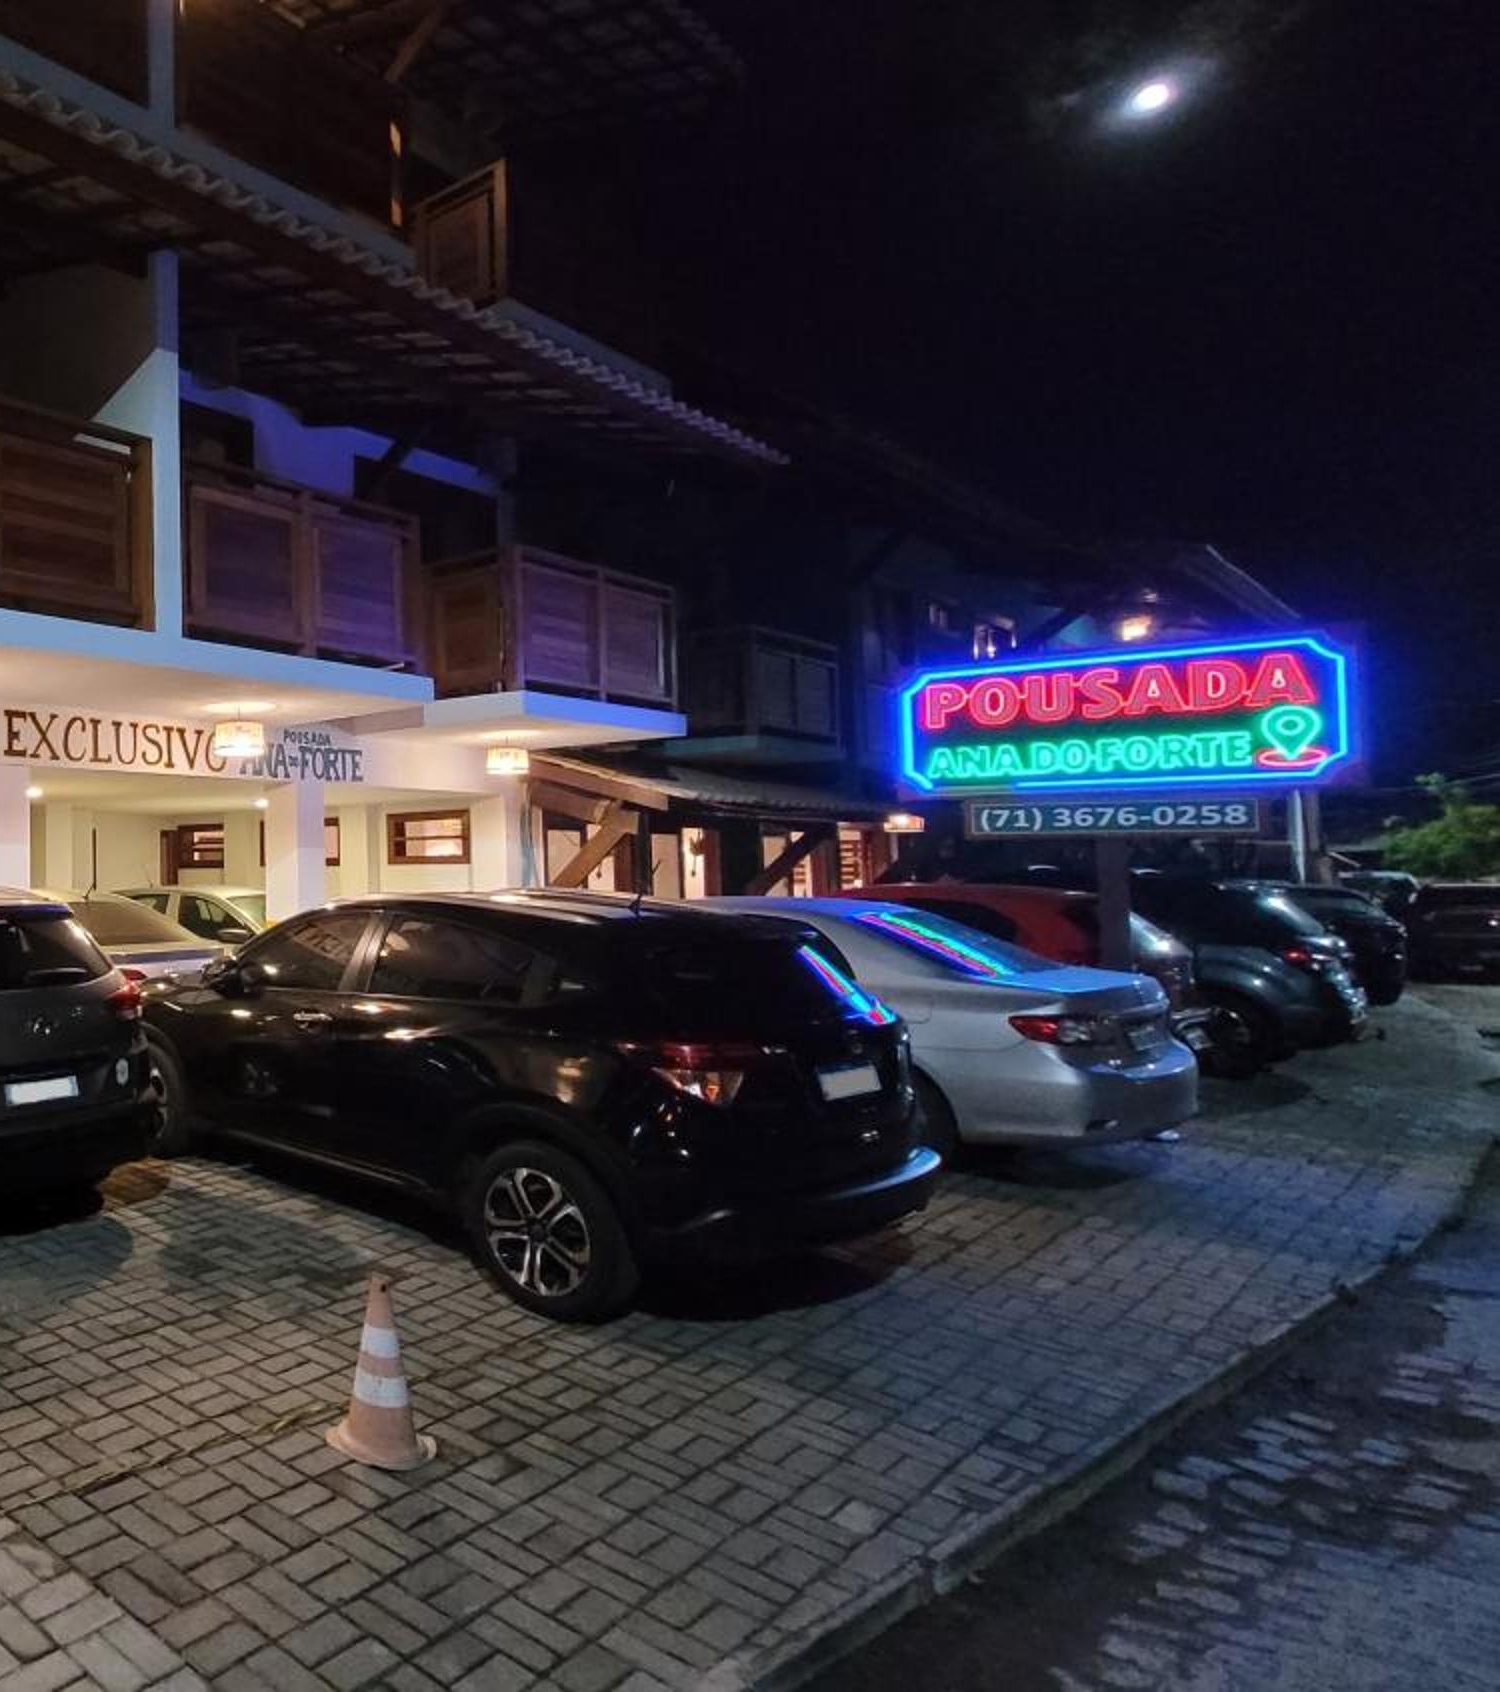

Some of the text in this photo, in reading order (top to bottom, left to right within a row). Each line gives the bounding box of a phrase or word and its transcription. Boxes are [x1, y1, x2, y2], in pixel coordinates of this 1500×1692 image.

[926, 653, 1316, 730] POUSADA
[298, 745, 364, 782] FORTE
[928, 731, 1252, 778] ANA DO FORTE
[980, 804, 1249, 831] (71) 3676-0258
